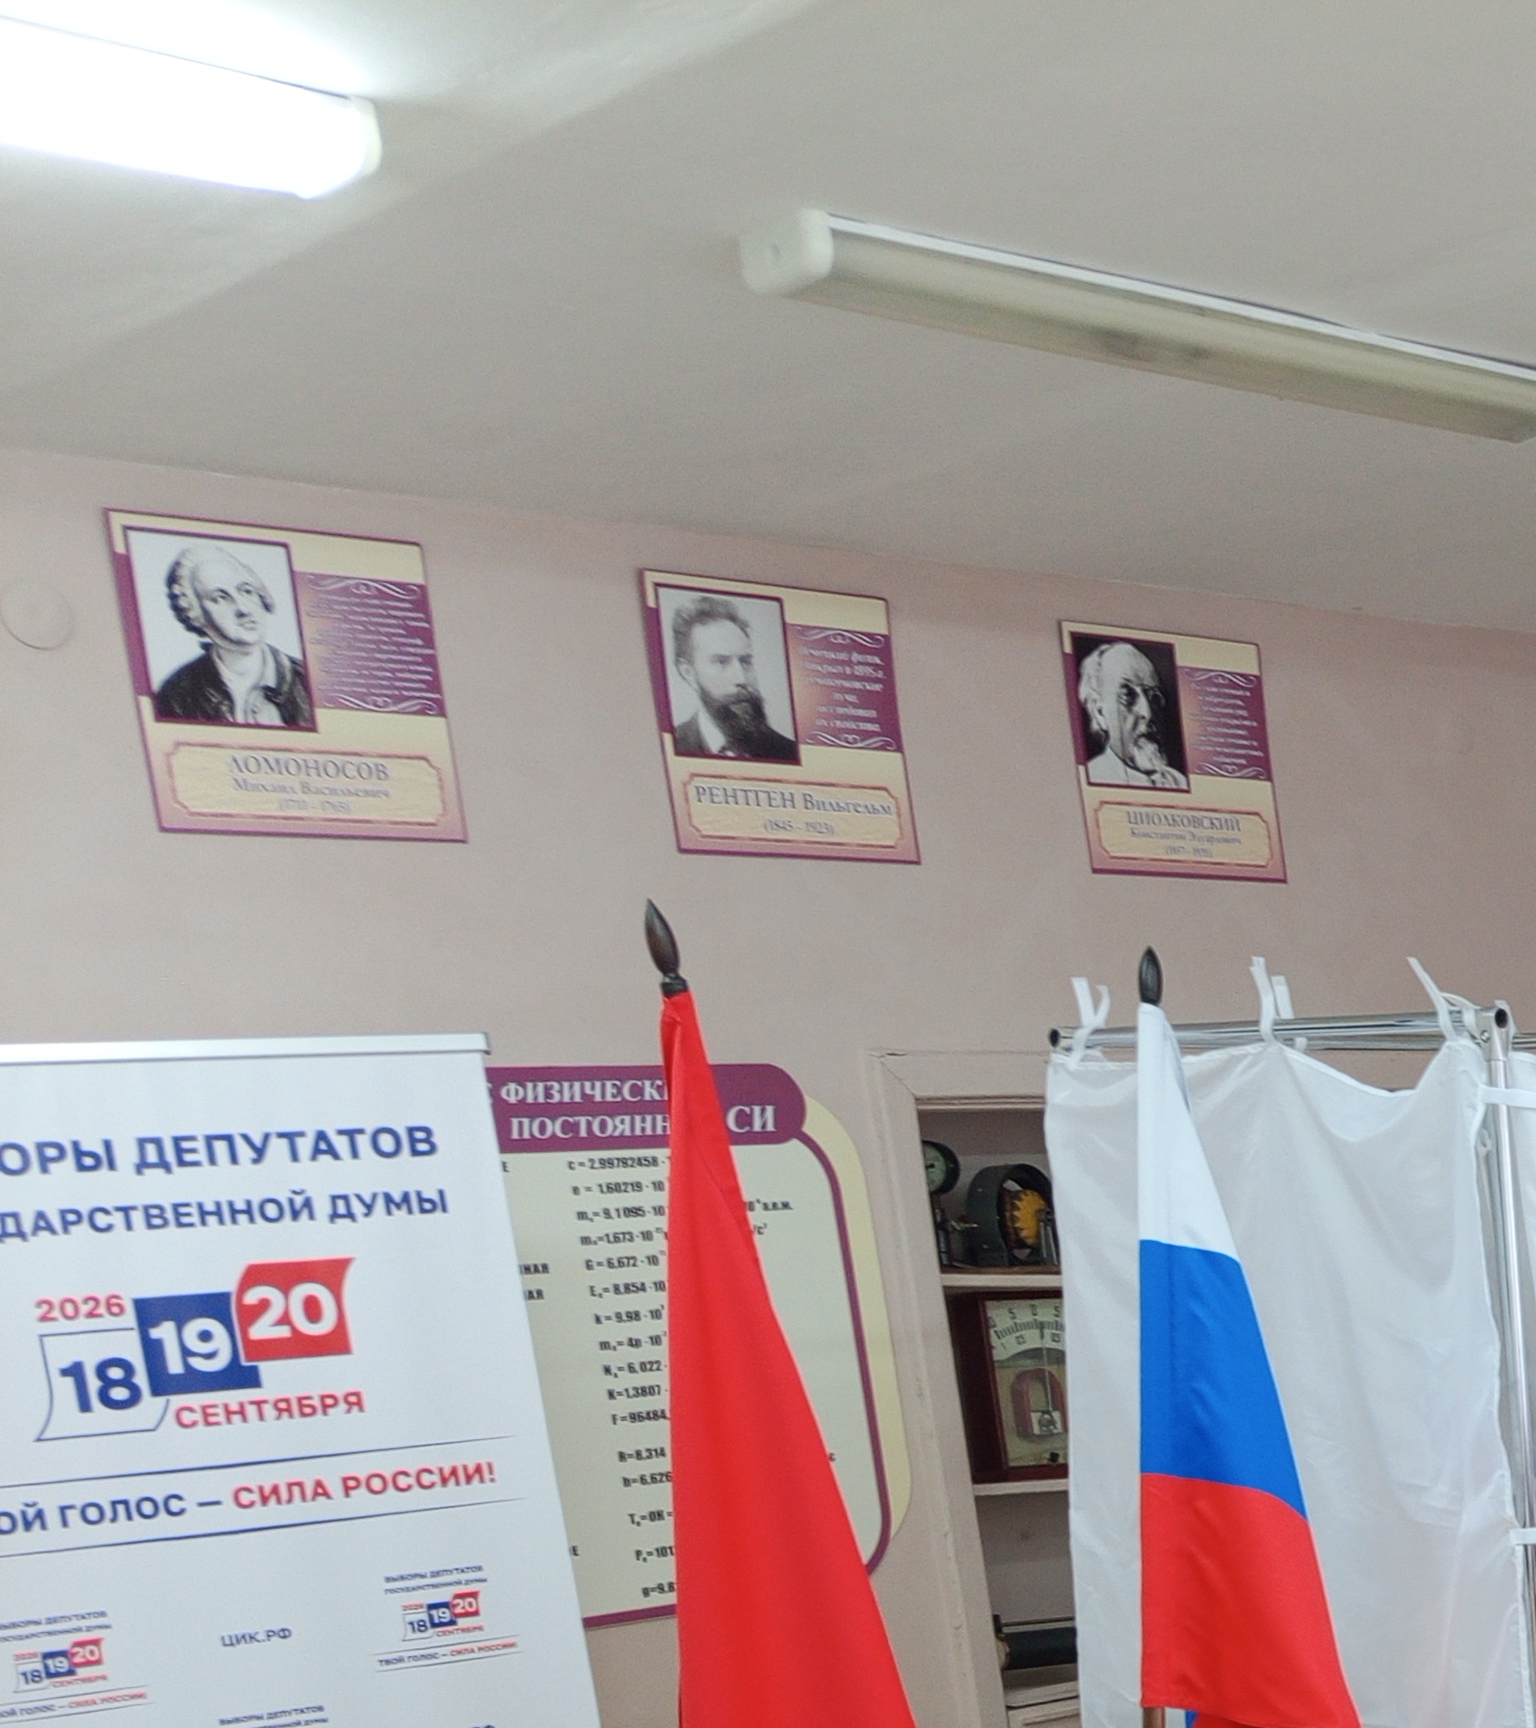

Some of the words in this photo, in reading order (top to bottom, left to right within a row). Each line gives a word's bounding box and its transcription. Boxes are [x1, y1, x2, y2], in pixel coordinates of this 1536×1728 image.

[231, 755, 389, 781] ЛОМОНОСОВ
[695, 785, 797, 809] РЕНТГЕН
[803, 793, 893, 816] Вильгельм
[726, 1105, 777, 1133] СИ
[134, 1125, 438, 1176] ДЕПУТАТОВ
[329, 1188, 448, 1224] ДУМЫ
[36, 1294, 127, 1323] 2026
[242, 1281, 340, 1341] 20
[150, 1315, 232, 1374] 19
[59, 1356, 142, 1414] 18
[174, 1390, 366, 1428] СЕНТЯБРЯ
[60, 1493, 187, 1529] ГОЛОС
[232, 1479, 334, 1510] СИЛА
[342, 1462, 497, 1498] РОССИИ!
[452, 1597, 477, 1612] 20
[221, 1627, 293, 1648] ЦИК.РФ
[408, 1620, 428, 1634] 18
